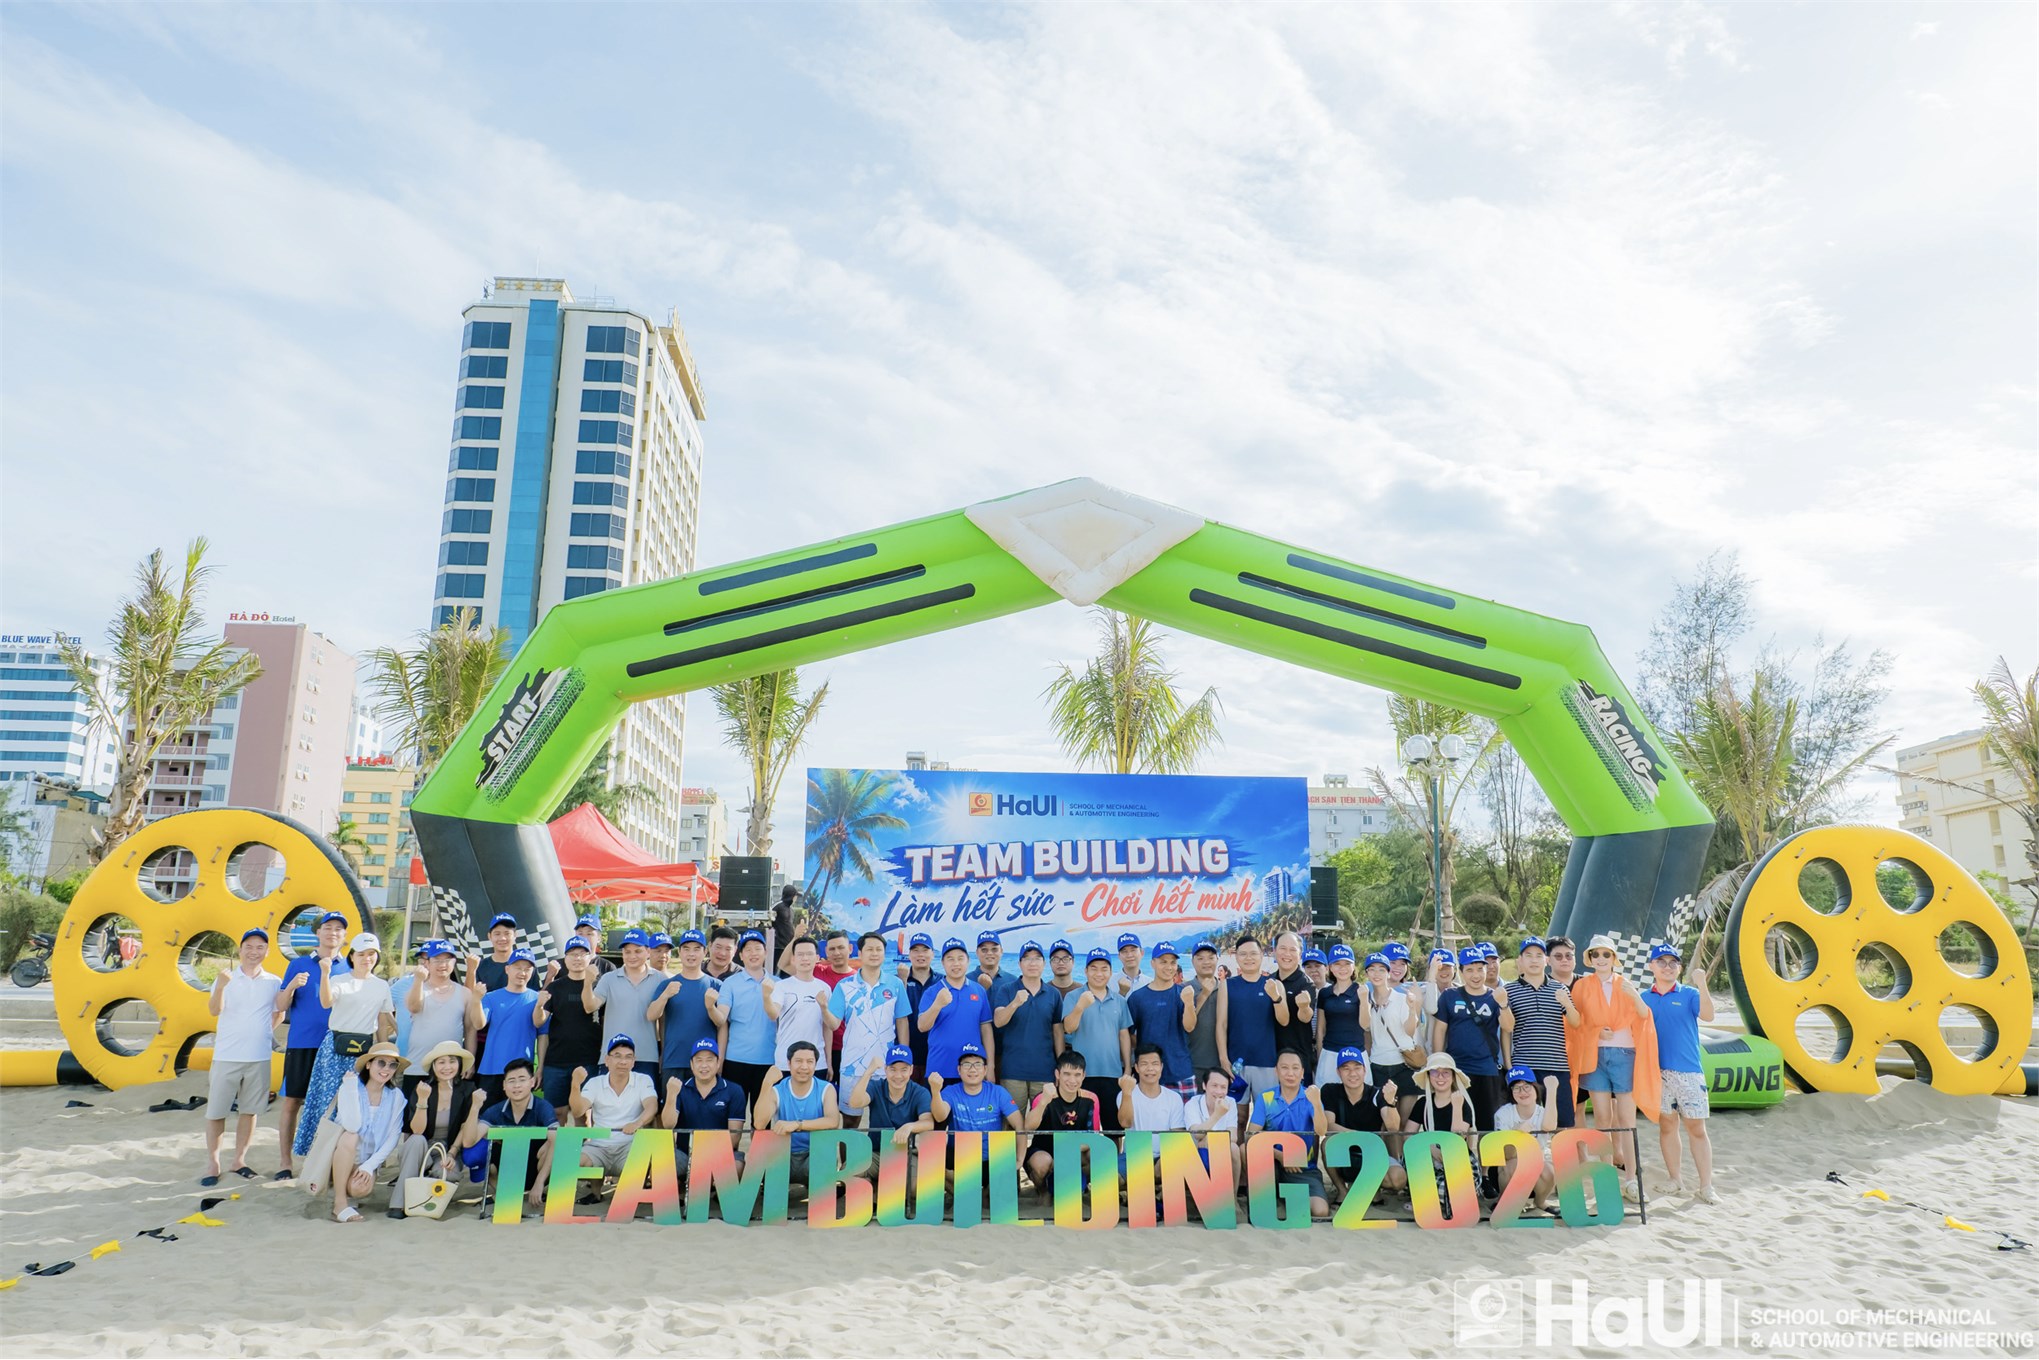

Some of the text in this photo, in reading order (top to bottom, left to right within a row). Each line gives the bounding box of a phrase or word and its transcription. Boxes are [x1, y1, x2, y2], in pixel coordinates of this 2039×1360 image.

[1, 635, 24, 643] BLUE
[27, 636, 52, 644] WAVE
[487, 691, 538, 762] START
[1592, 695, 1652, 774] RACING
[997, 794, 1057, 816] HaUI
[905, 838, 1230, 883] TEAM BUILDING
[876, 890, 945, 935] Làm
[952, 881, 1005, 924] hết
[1007, 888, 1056, 918] sức
[1081, 882, 1142, 922] Chơi
[1149, 882, 1194, 915] hết
[1199, 877, 1255, 913] mình
[1454, 1001, 1492, 1016] FA
[1707, 1064, 1780, 1093] DING
[487, 1127, 1625, 1230] TEAM BUILDING 2026
